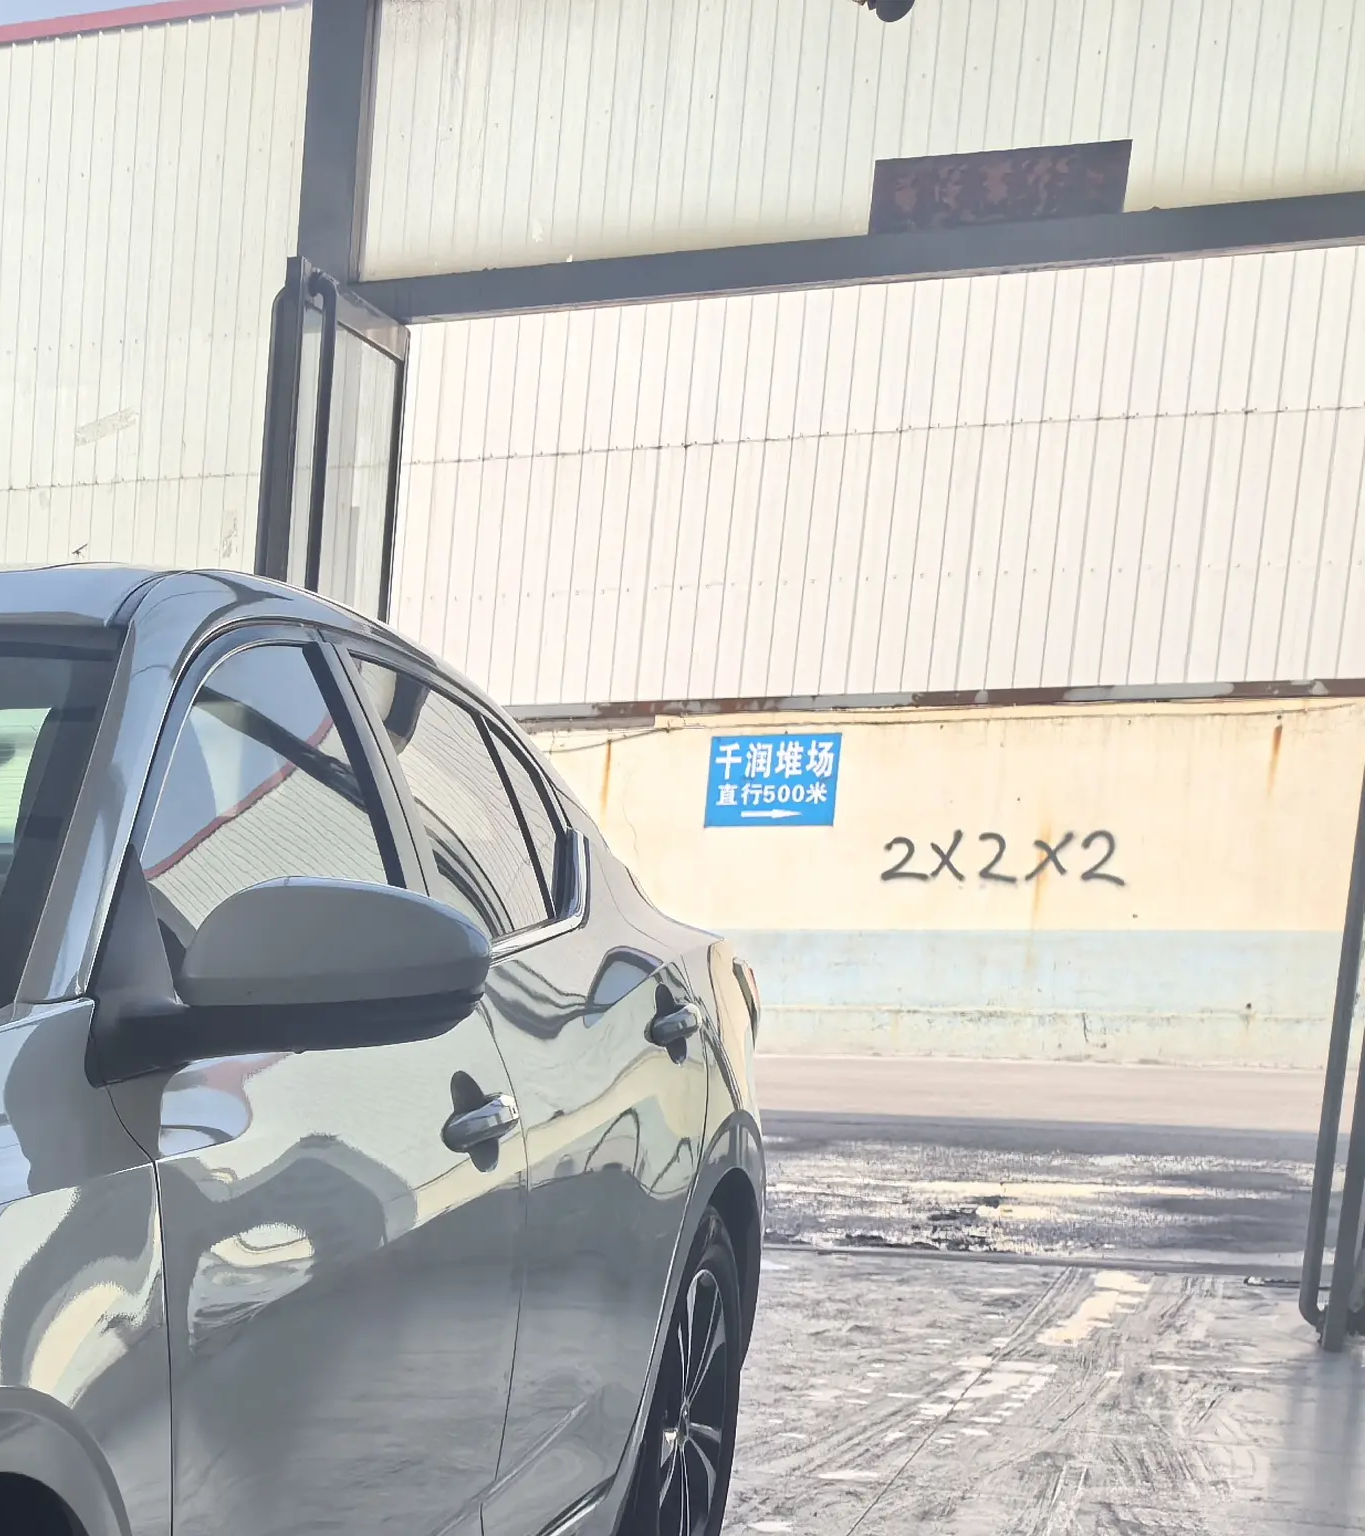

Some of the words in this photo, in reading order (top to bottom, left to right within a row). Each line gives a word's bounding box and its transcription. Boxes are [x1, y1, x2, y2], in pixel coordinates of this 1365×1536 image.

[715, 739, 834, 780] 千润堆场
[715, 781, 828, 806] 直行500米
